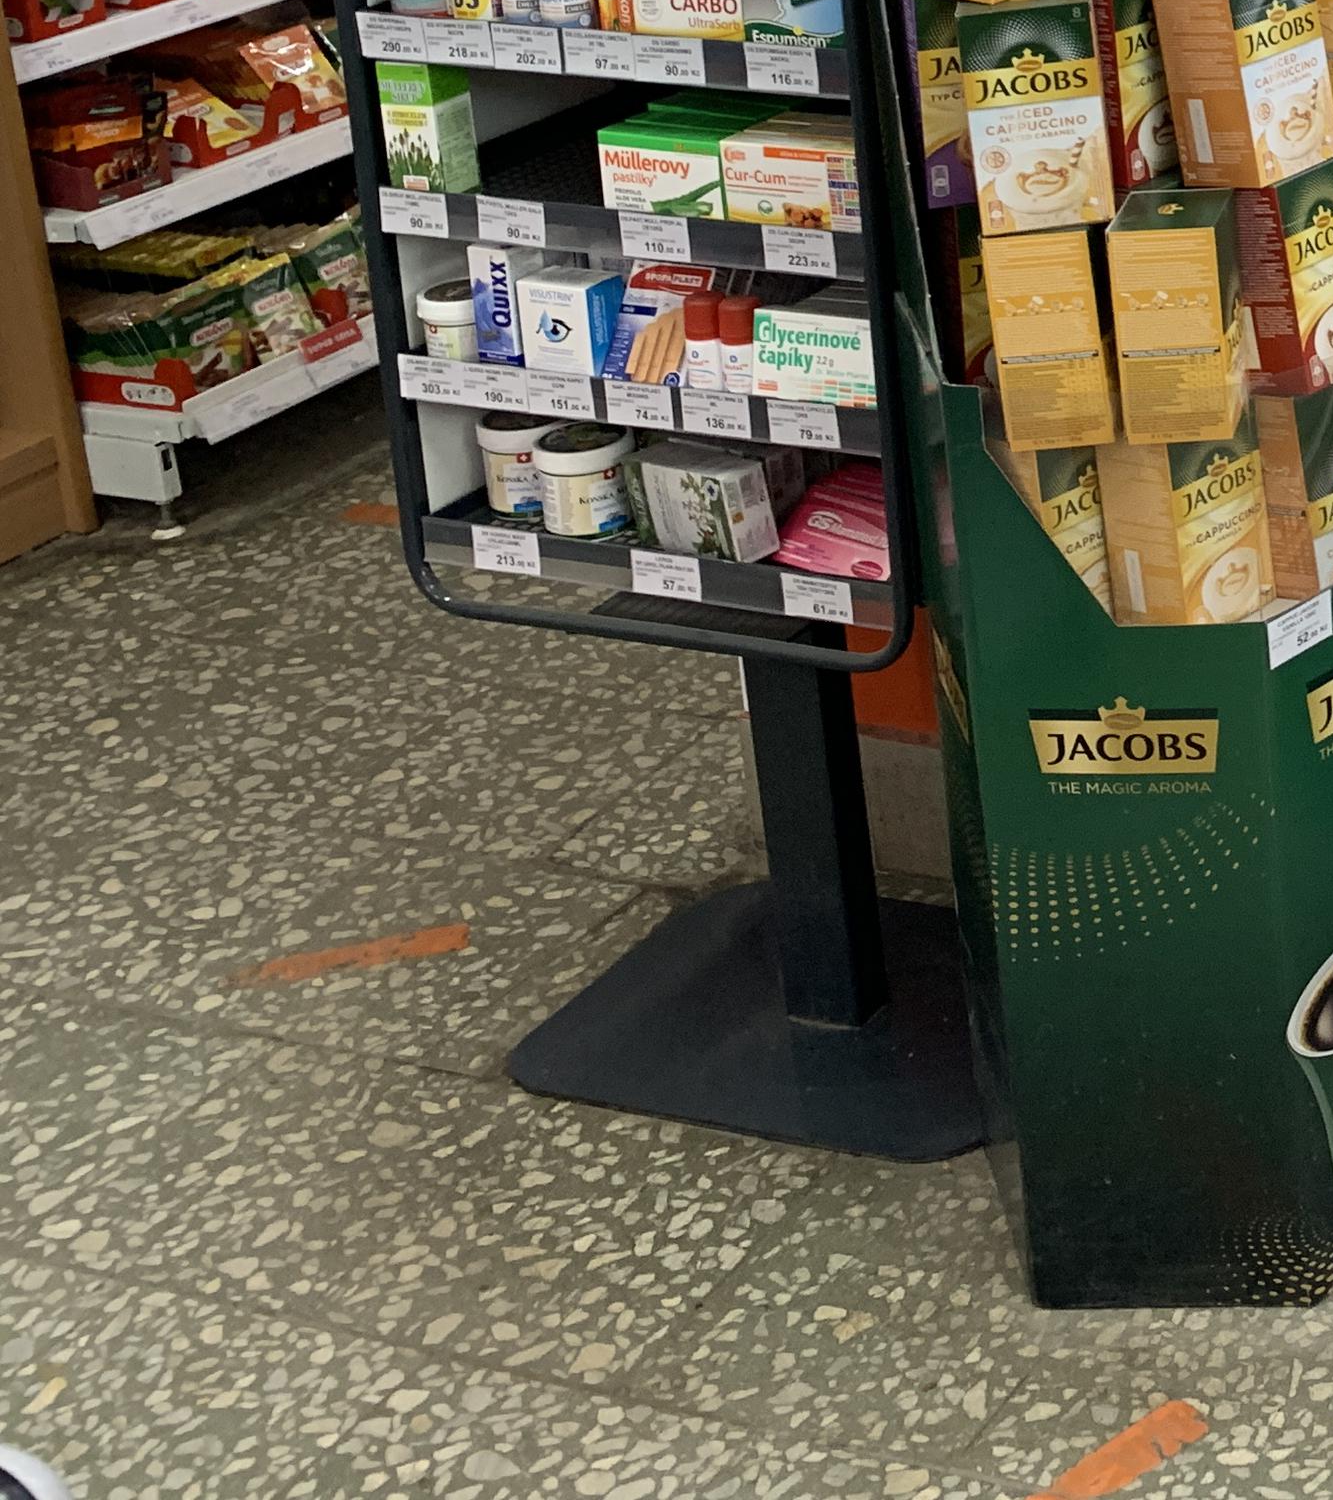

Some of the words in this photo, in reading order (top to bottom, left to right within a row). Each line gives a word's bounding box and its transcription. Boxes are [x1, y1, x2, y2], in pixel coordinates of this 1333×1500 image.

[688, 16, 742, 32] UltraSorb
[1244, 11, 1316, 58] JACOBS
[974, 66, 1089, 104] JACOBS
[984, 113, 1088, 138] CAPPUCCINO
[1016, 103, 1054, 120] ICED
[604, 149, 691, 180] Müllerovy
[725, 165, 787, 186] Cur-Cum
[612, 171, 654, 188] pastilky
[490, 260, 513, 329] QUIXX
[757, 313, 861, 351] Glycerinové
[757, 346, 814, 374] čapíky
[1183, 460, 1257, 517] JACOBS
[1047, 732, 1208, 766] JACOBS
[1047, 780, 1081, 795] THE
[1085, 780, 1143, 795] MAGIC
[1146, 780, 1213, 795] AROMA
